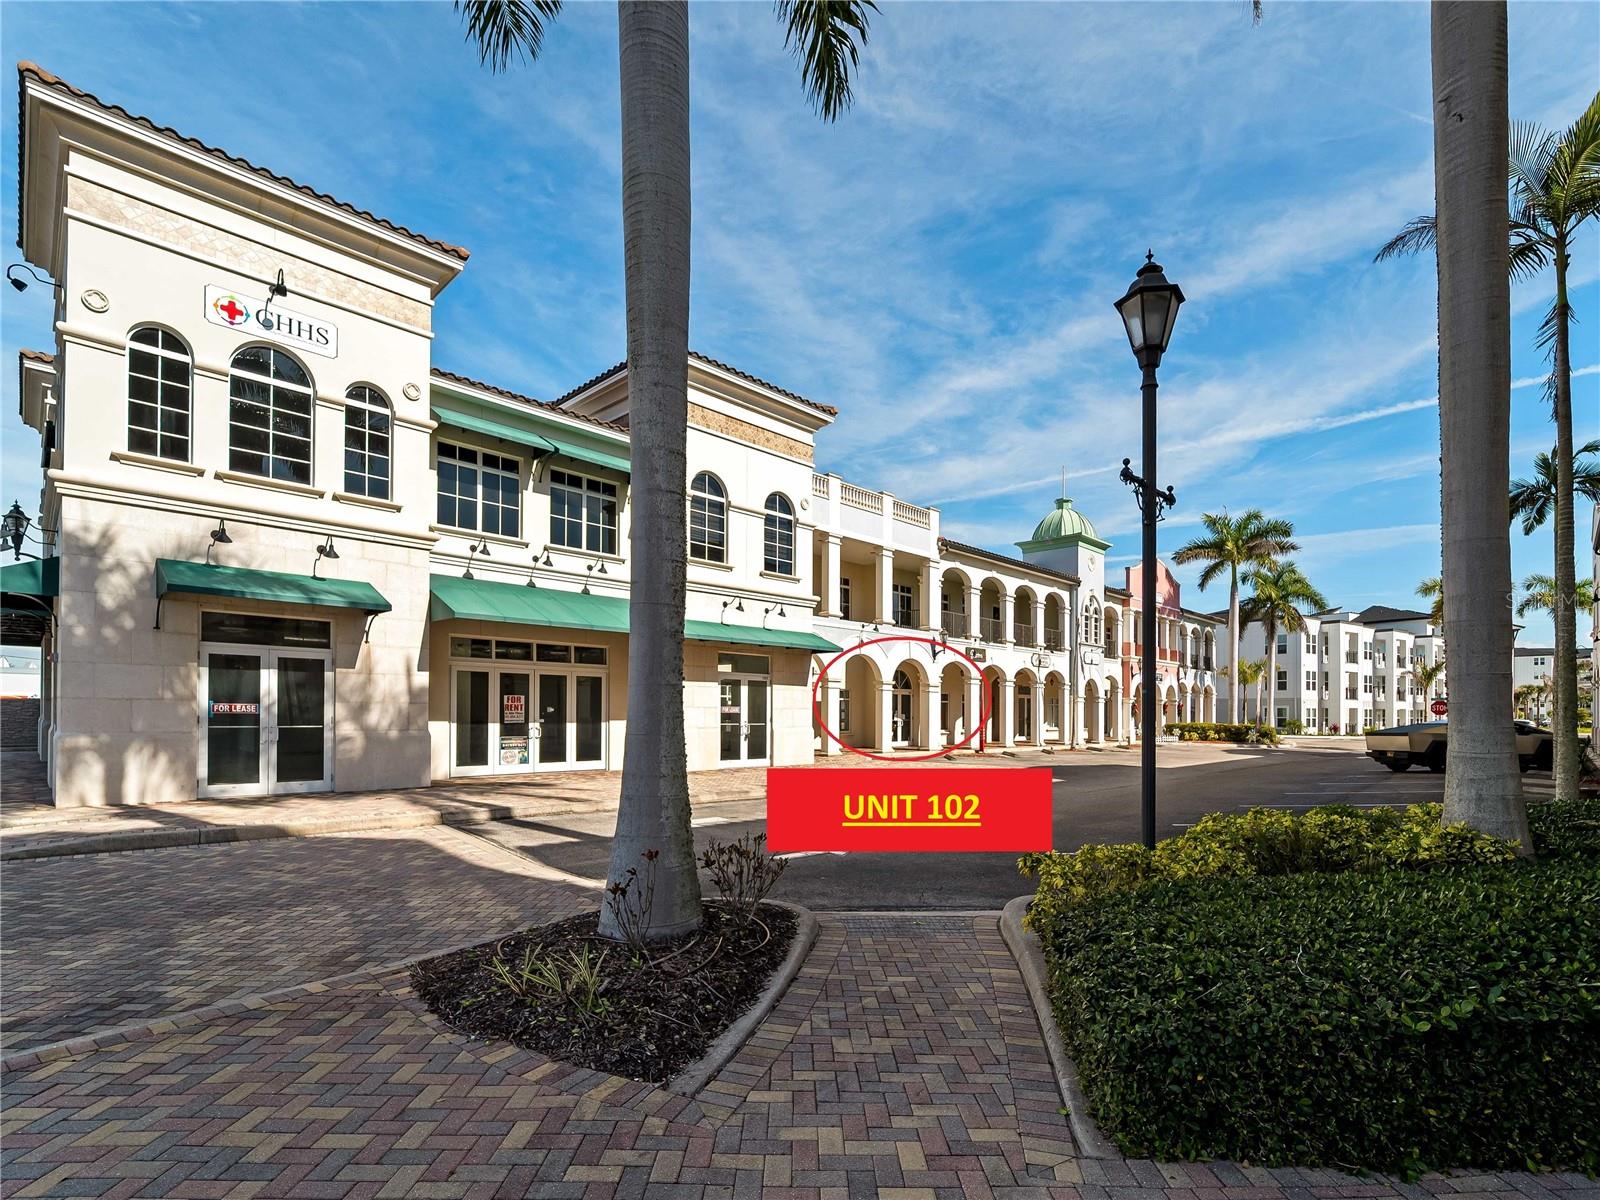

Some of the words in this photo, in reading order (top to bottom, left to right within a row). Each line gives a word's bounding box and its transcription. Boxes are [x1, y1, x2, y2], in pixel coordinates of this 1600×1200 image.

[255, 308, 329, 345] CHHS
[506, 696, 521, 704] FOR
[213, 704, 230, 712] FOR
[231, 704, 256, 712] LEASE
